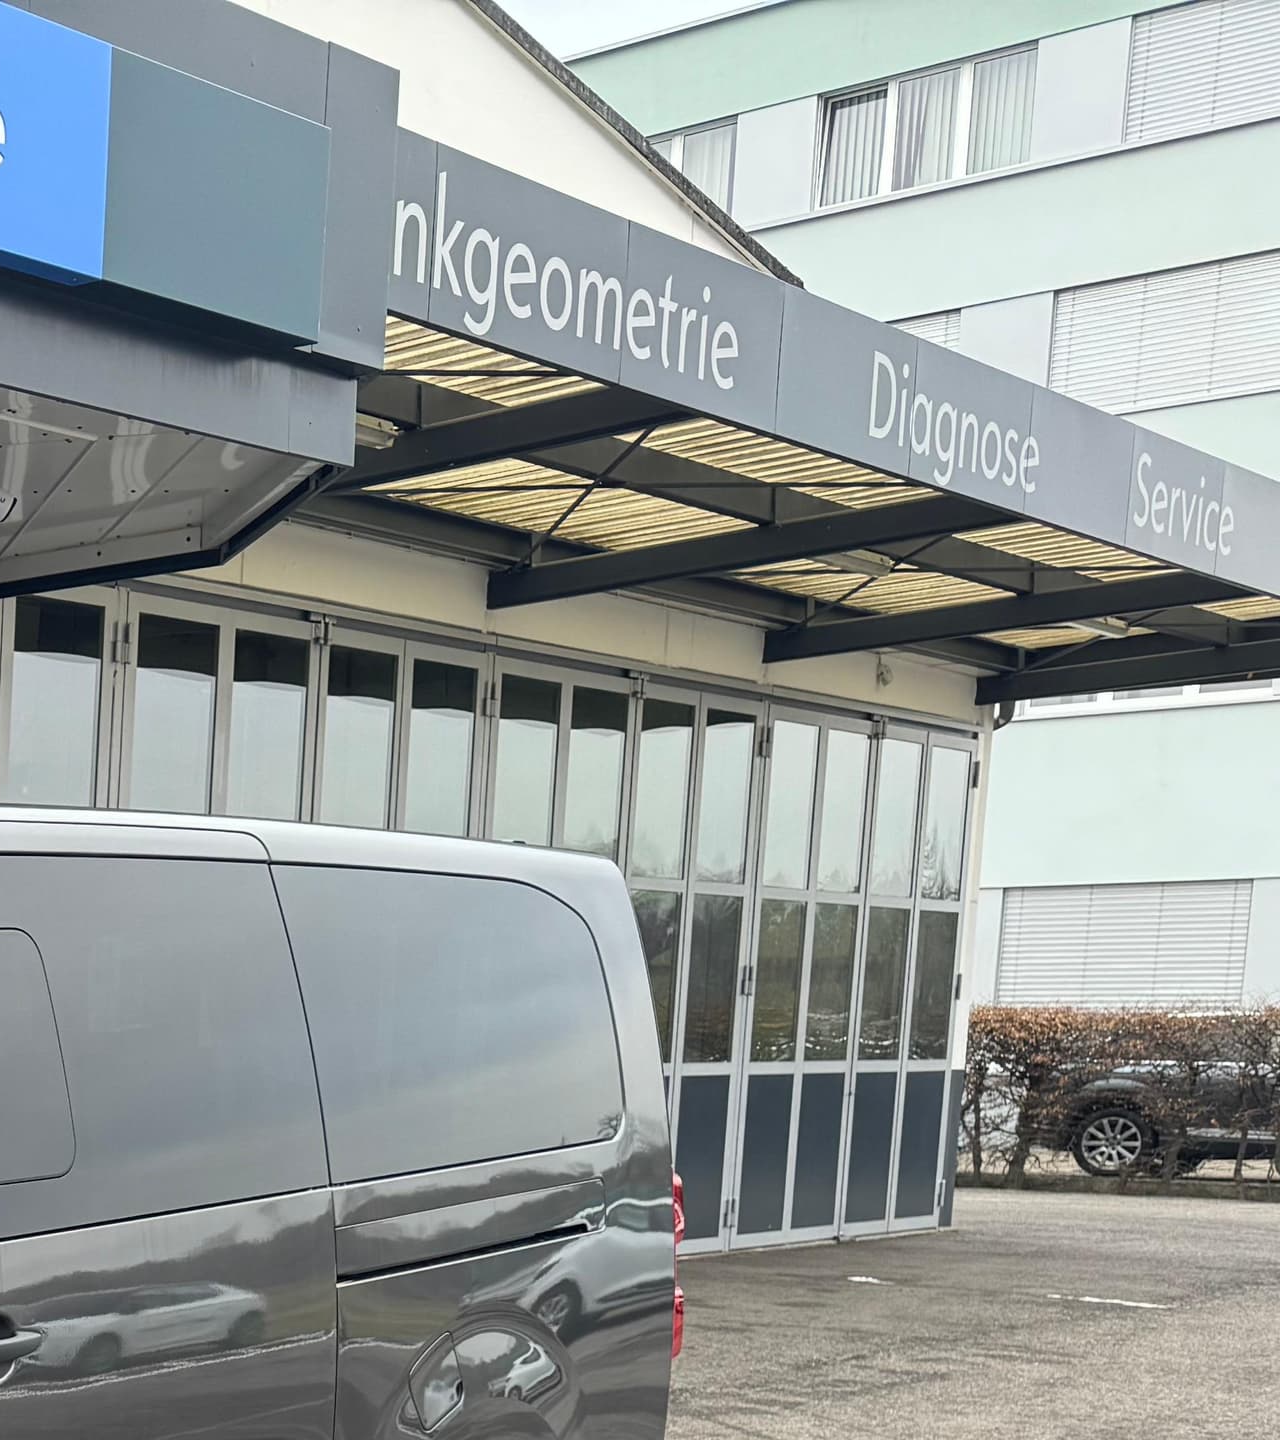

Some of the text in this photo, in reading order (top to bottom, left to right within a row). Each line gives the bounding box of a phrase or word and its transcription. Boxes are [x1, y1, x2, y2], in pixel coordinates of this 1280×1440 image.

[393, 171, 739, 390] nkgeometrie
[869, 350, 1040, 493] Diagnose
[1134, 451, 1235, 556] Service
